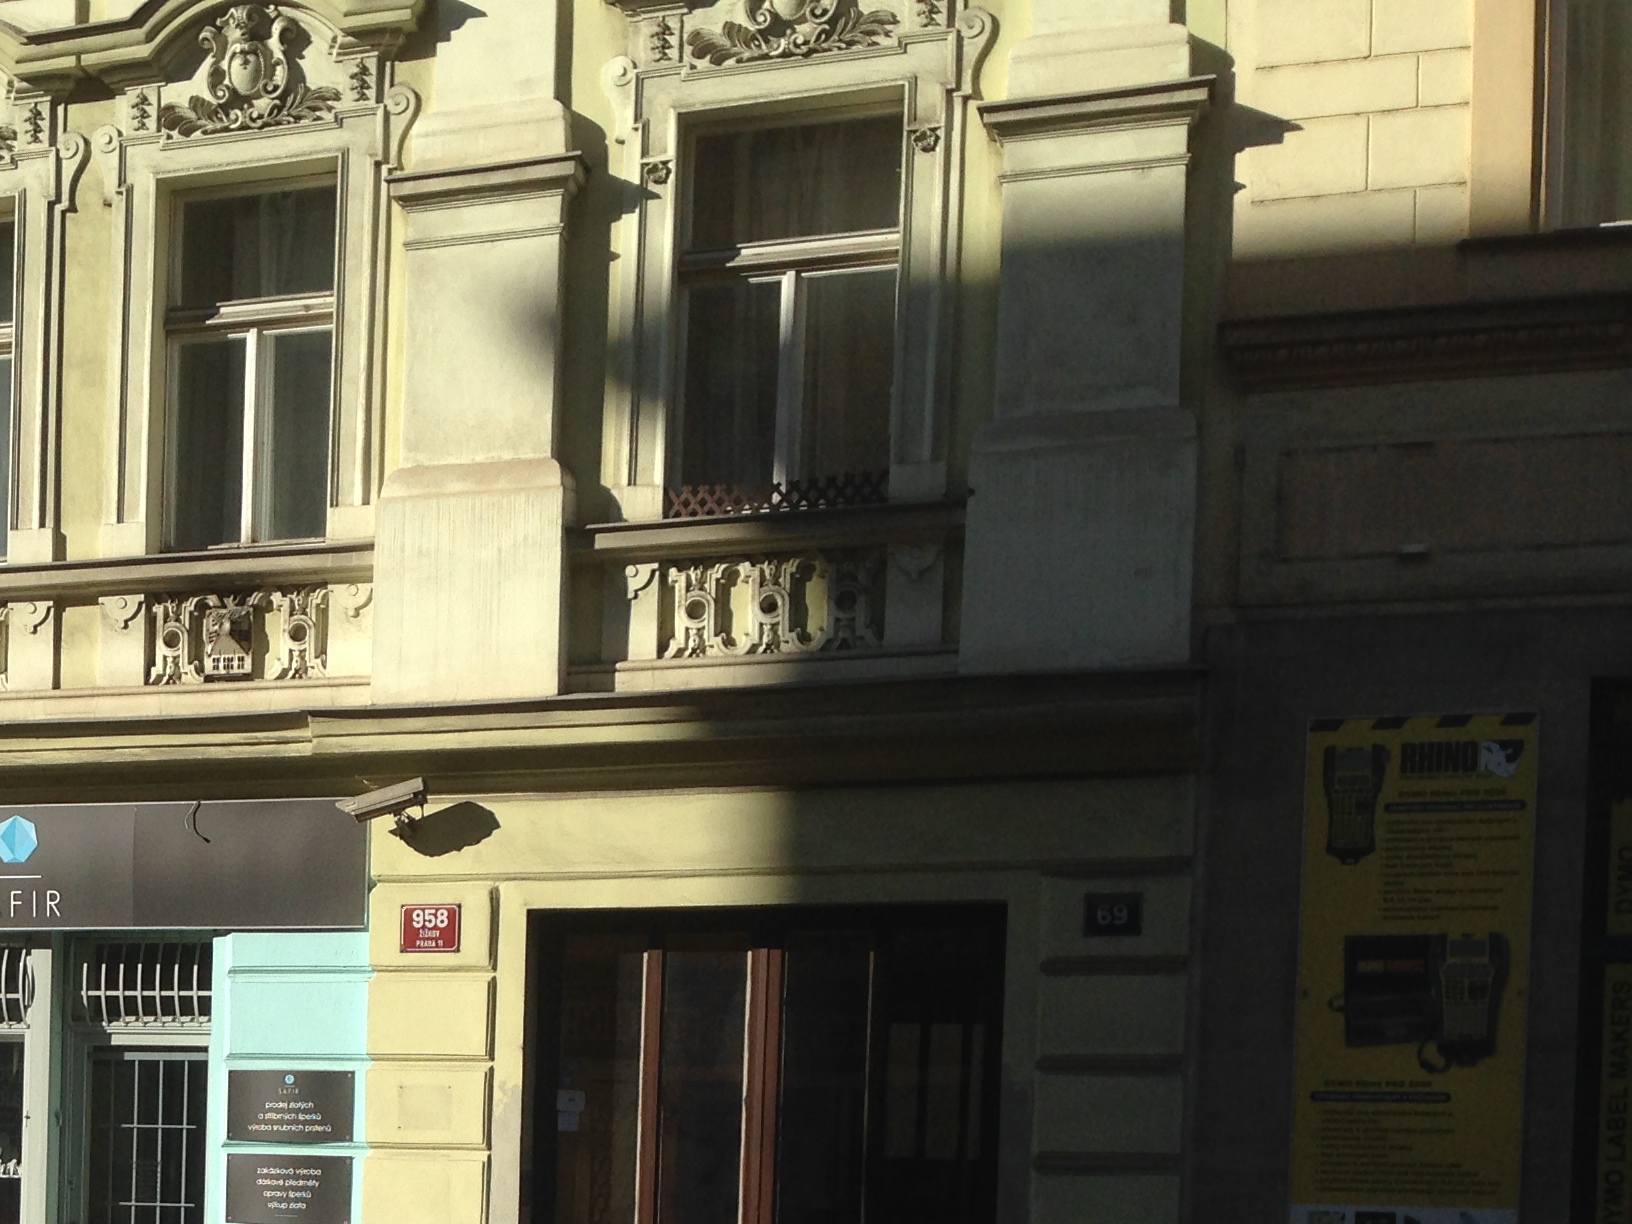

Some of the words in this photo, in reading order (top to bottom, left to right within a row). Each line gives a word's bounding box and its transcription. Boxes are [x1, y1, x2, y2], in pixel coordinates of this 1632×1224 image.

[1400, 741, 1478, 774] RHINO
[1614, 846, 1632, 914] DYMO
[412, 908, 449, 928] 958
[1096, 903, 1129, 925] 69
[1608, 980, 1632, 1079] MAKERS
[1604, 1086, 1629, 1163] LABEL
